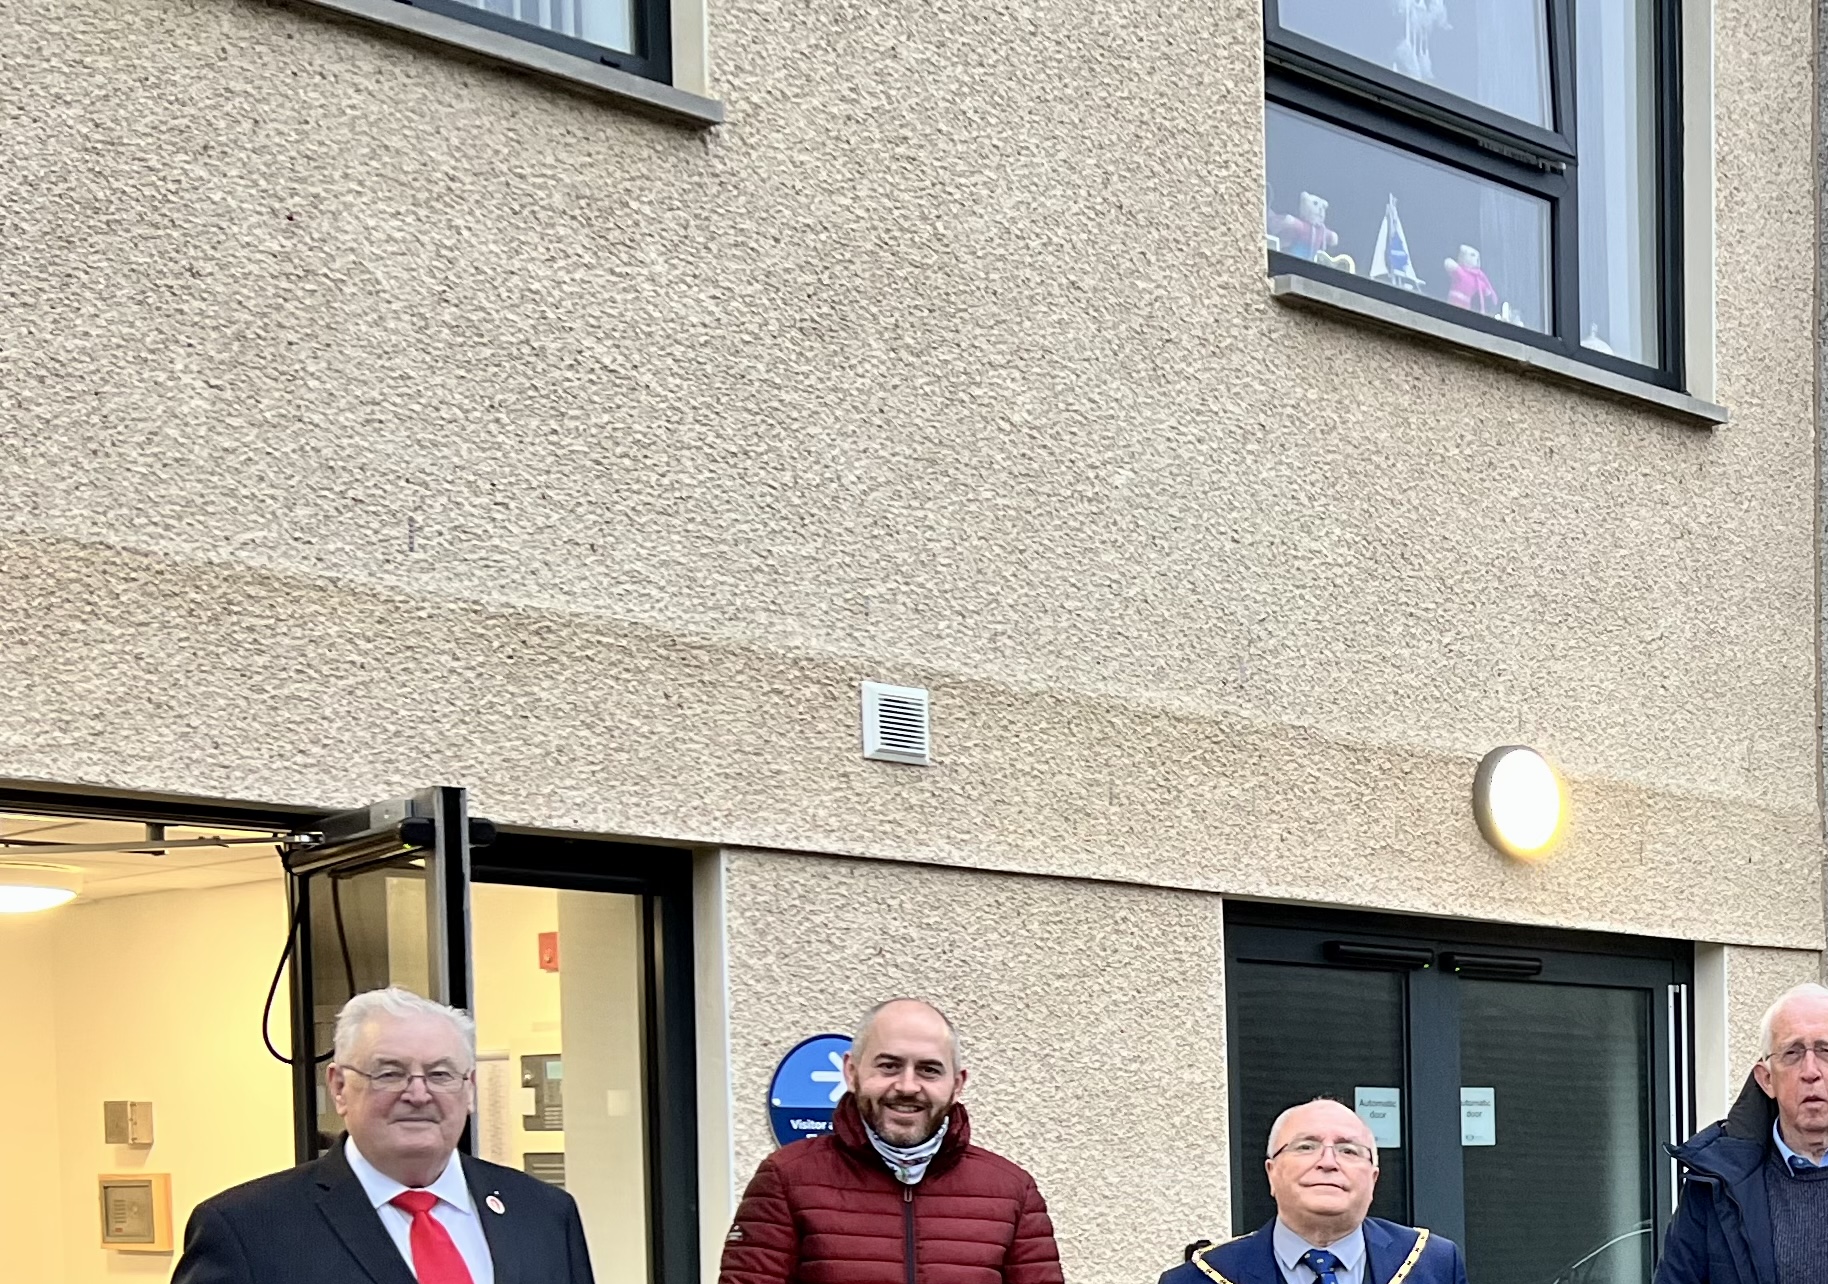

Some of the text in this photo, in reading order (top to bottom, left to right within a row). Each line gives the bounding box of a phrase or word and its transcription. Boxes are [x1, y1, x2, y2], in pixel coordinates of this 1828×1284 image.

[1460, 1099, 1491, 1107] utomatic
[1369, 1110, 1387, 1119] door
[790, 1119, 827, 1130] Visitor
